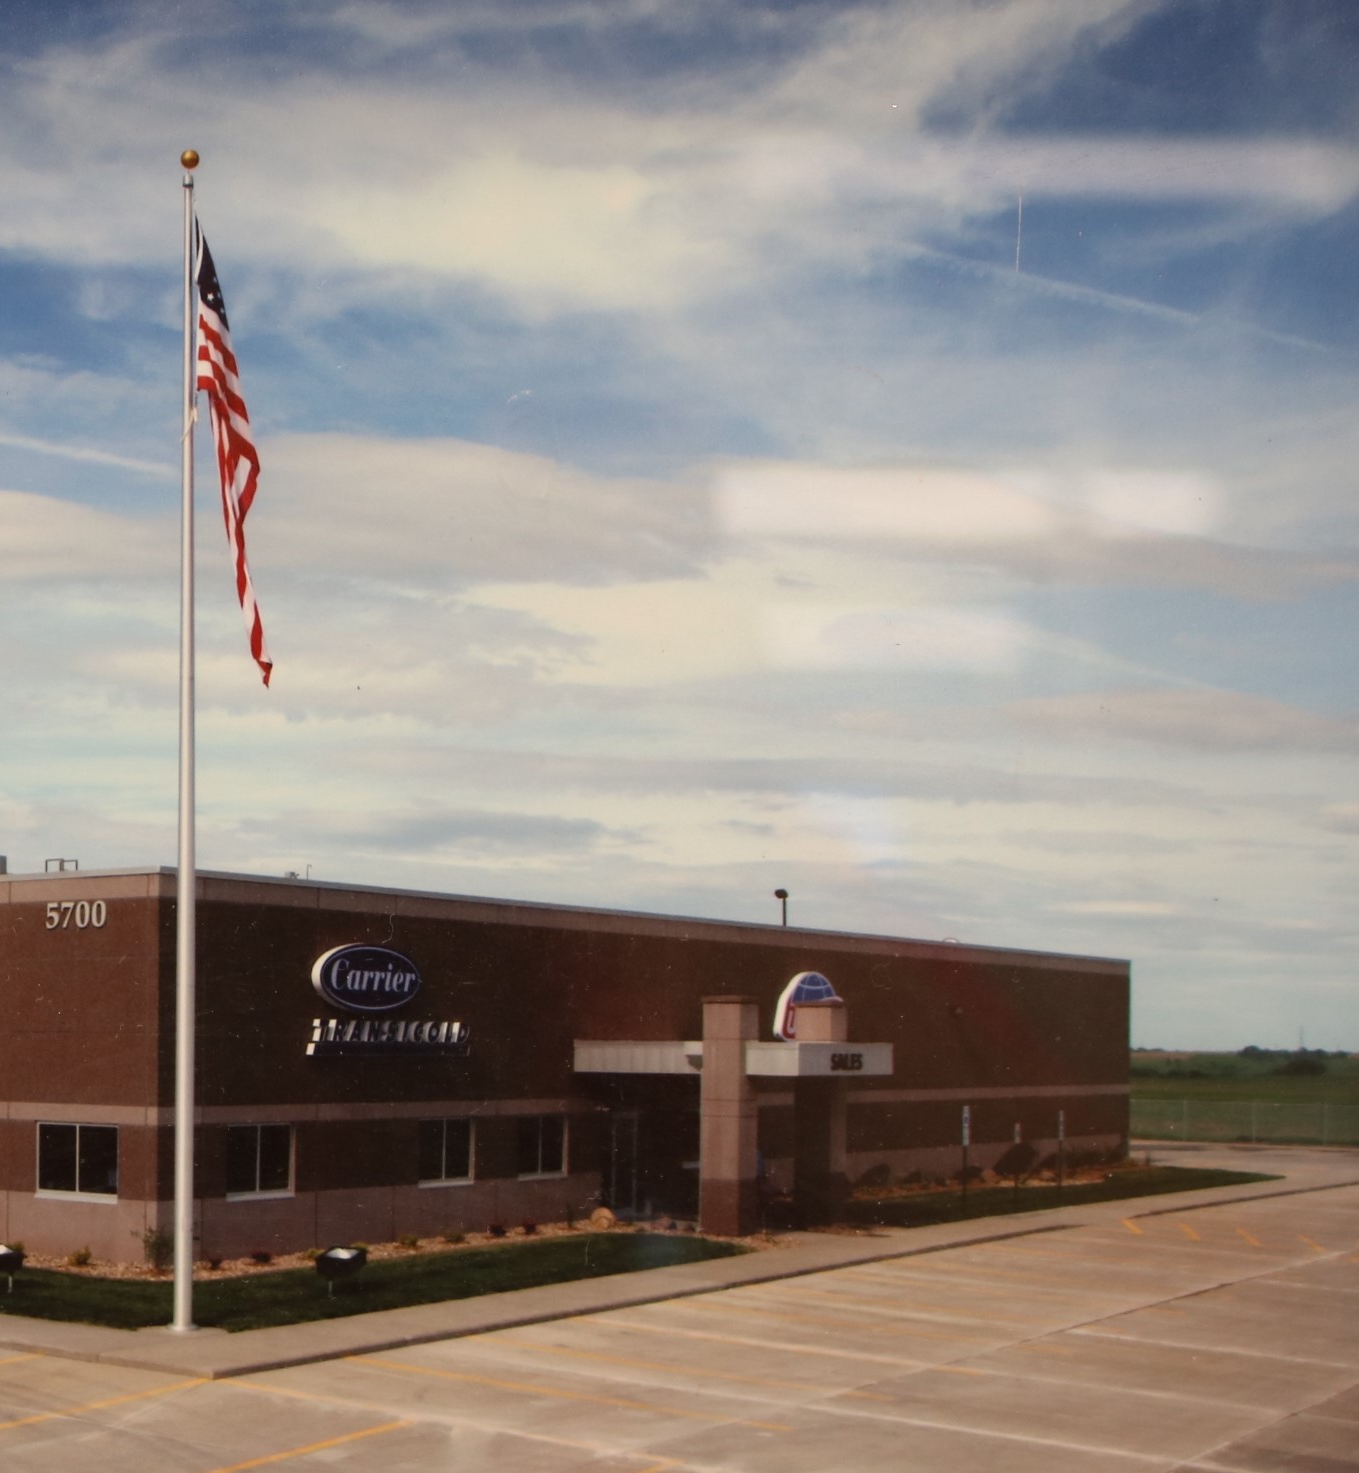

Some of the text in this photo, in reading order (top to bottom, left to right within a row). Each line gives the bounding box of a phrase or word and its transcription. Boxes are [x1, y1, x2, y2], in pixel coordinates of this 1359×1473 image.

[45, 900, 106, 929] 5700
[330, 958, 416, 992] Carrier
[830, 1053, 863, 1071] SALES
